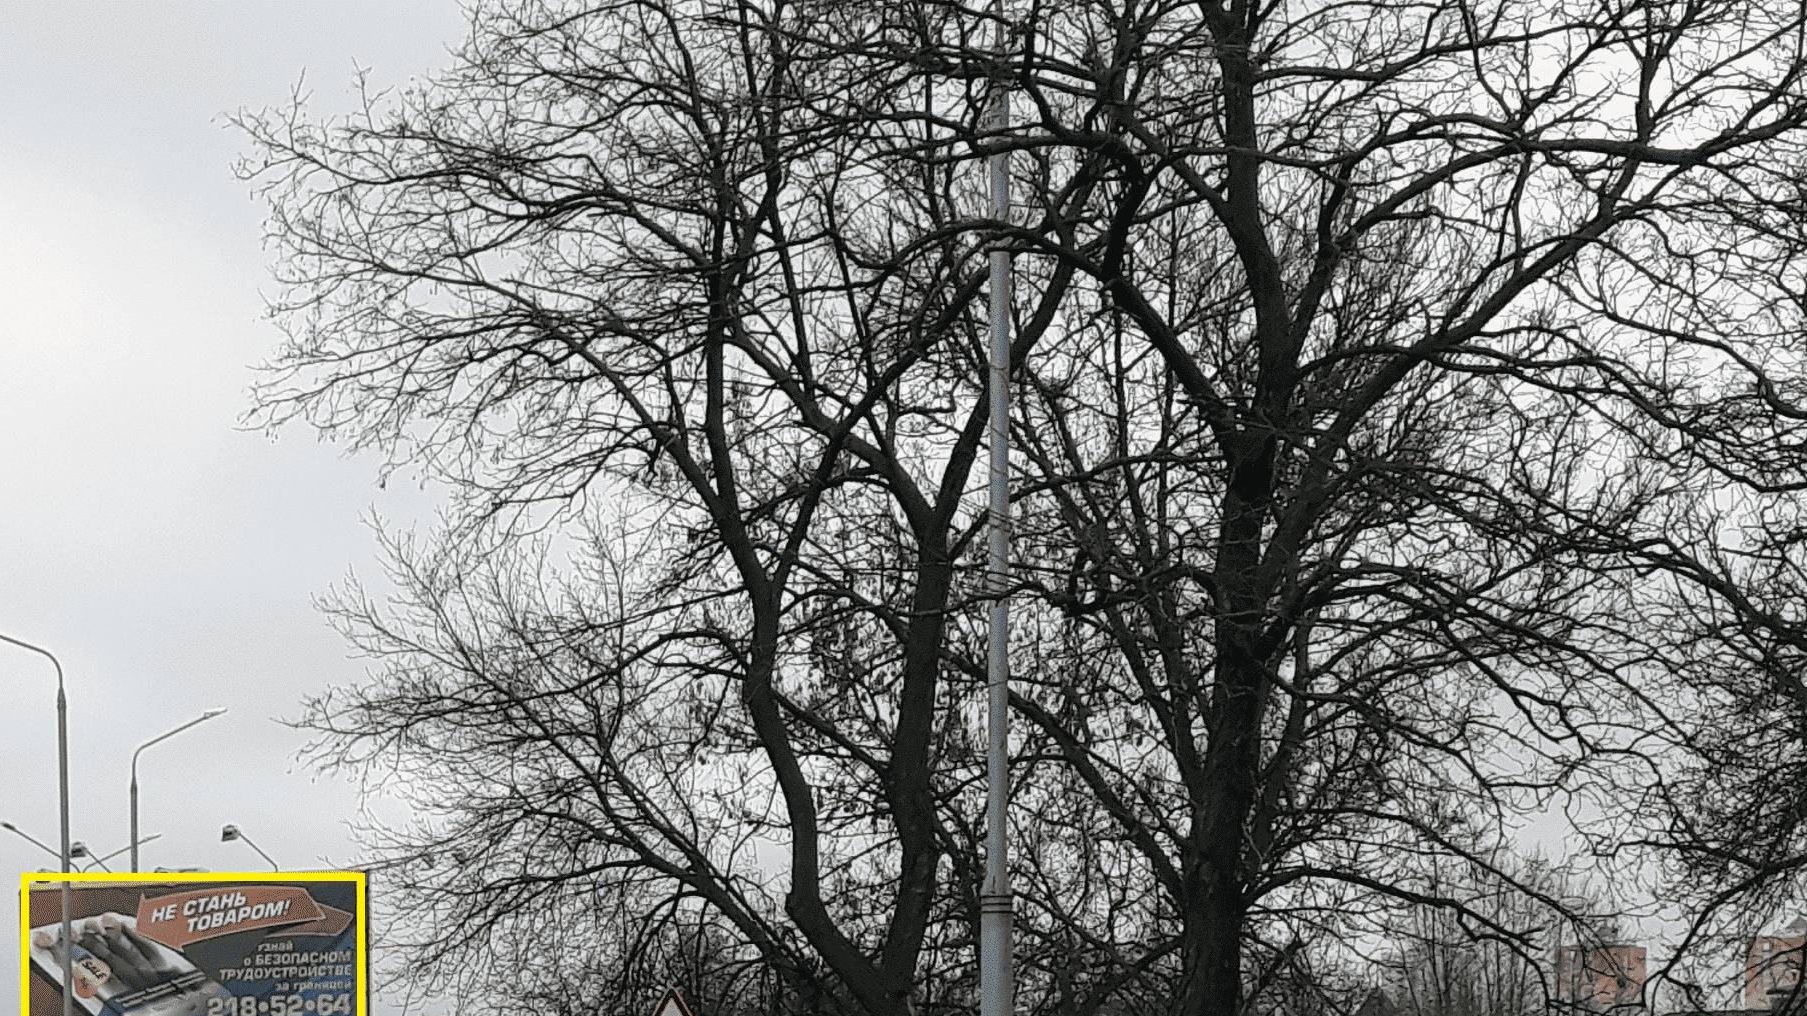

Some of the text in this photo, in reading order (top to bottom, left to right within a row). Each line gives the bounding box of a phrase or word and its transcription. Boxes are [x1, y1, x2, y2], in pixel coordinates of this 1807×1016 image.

[151, 891, 247, 923] НЕ СТАНЬ
[187, 899, 292, 933] ТОВАРОМ!
[255, 950, 352, 966] БЕЗОПАСНОМ
[219, 963, 353, 981] ТРУДОУСТРОЙСТВЕ
